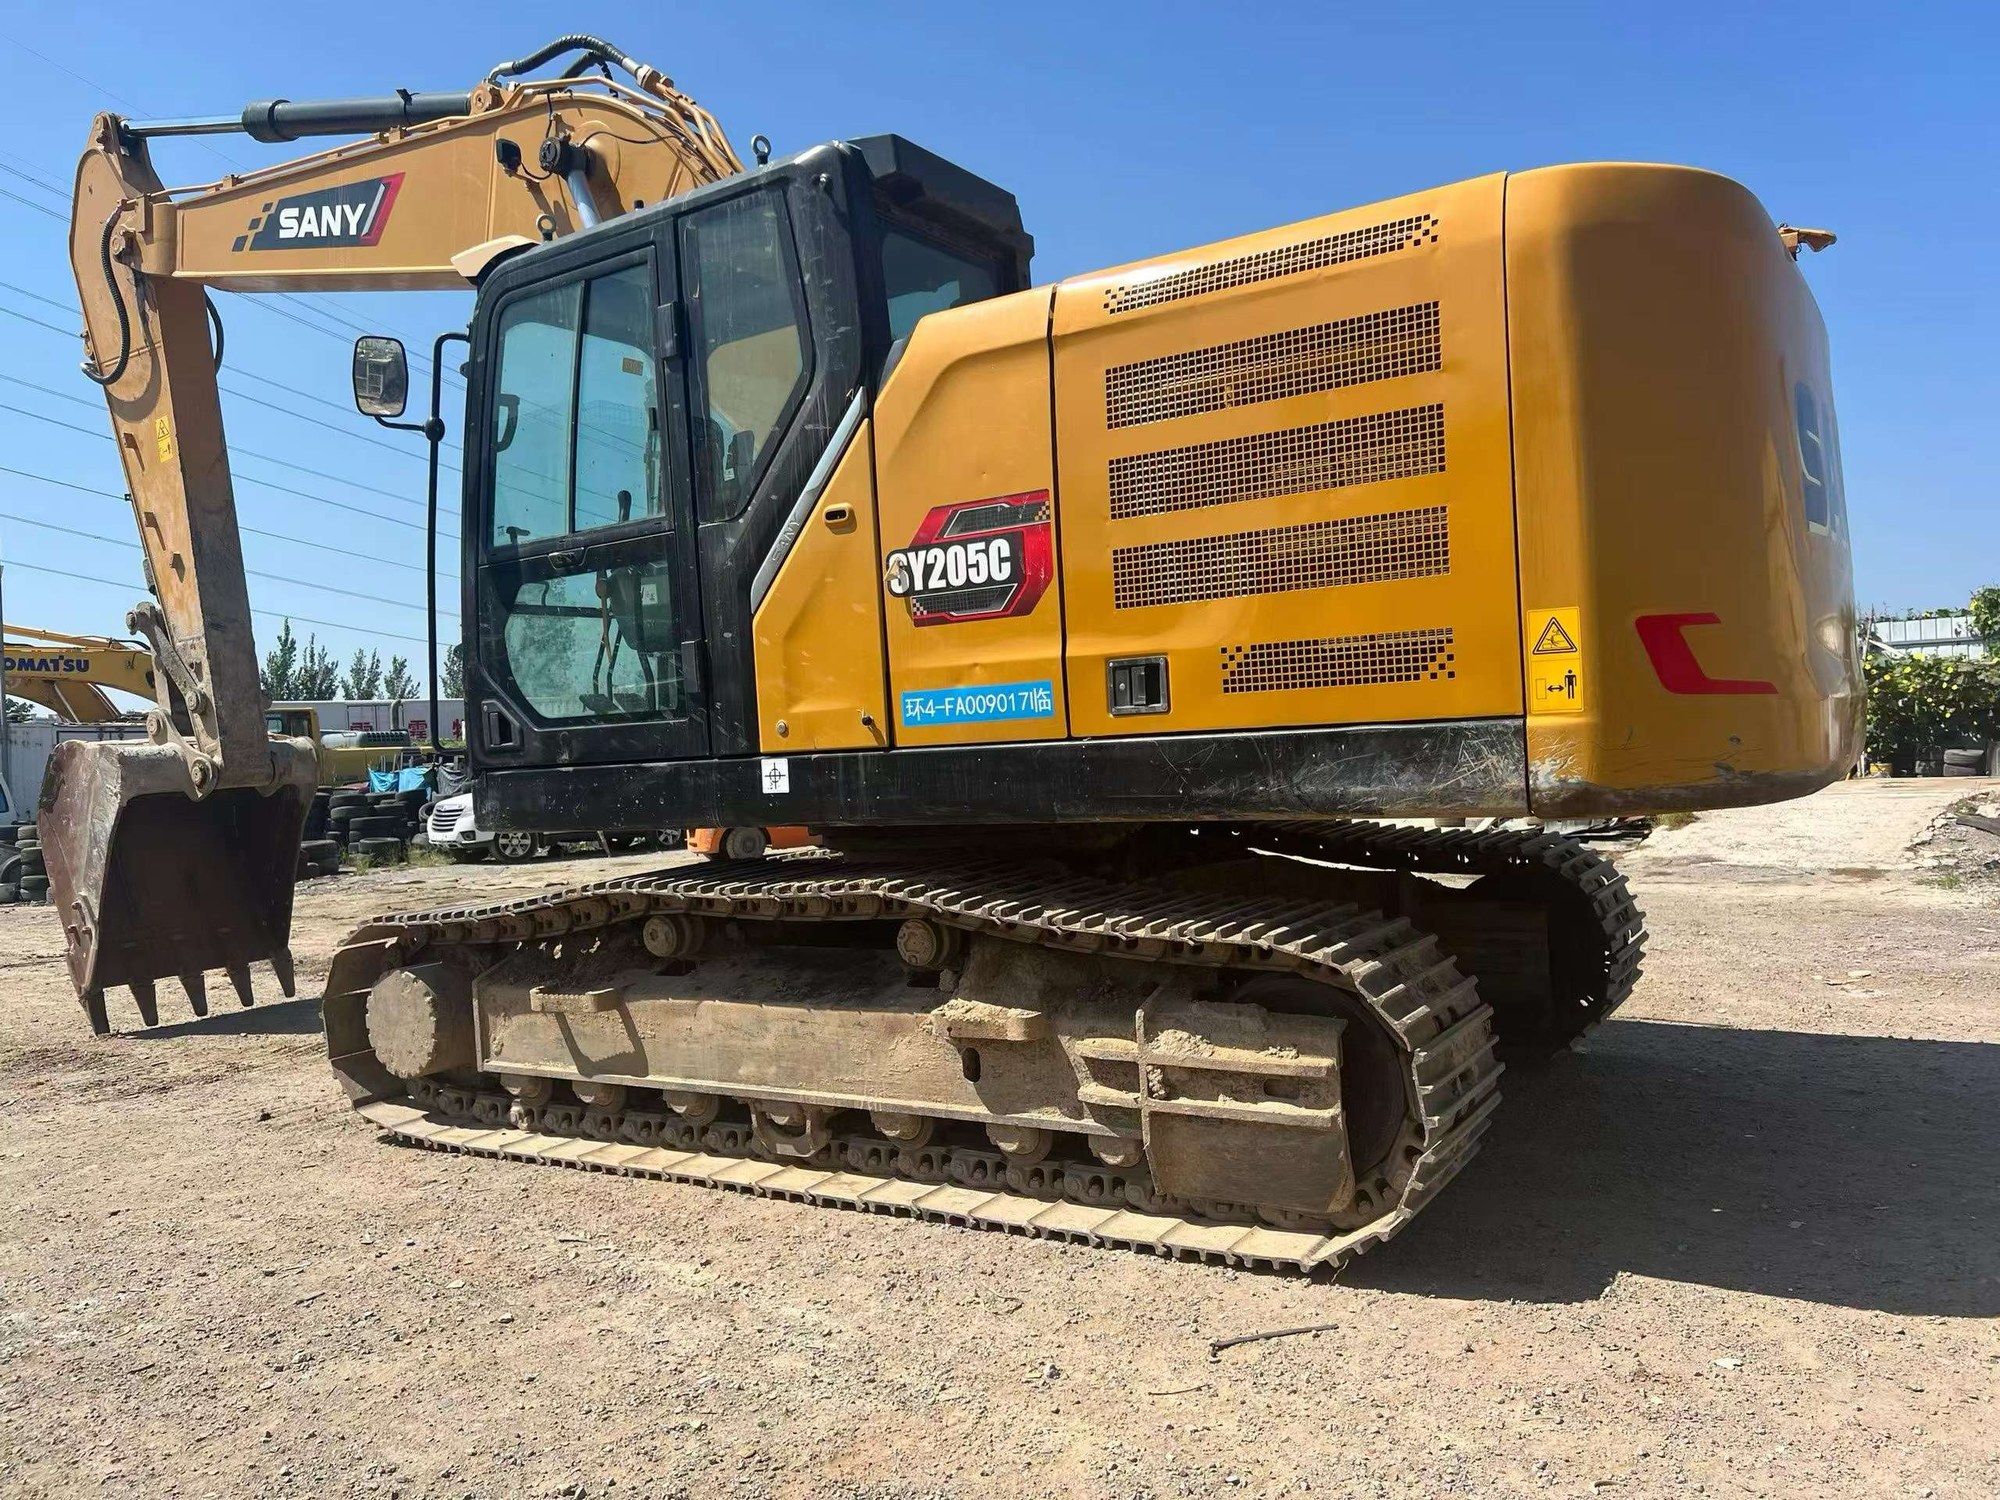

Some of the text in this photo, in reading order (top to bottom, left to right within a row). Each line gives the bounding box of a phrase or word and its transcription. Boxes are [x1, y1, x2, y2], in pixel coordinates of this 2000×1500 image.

[279, 203, 366, 239] SANY
[888, 538, 1012, 594] SY205C
[3, 655, 90, 673] OMATSU
[905, 687, 1051, 721] 环4-FA009017临
